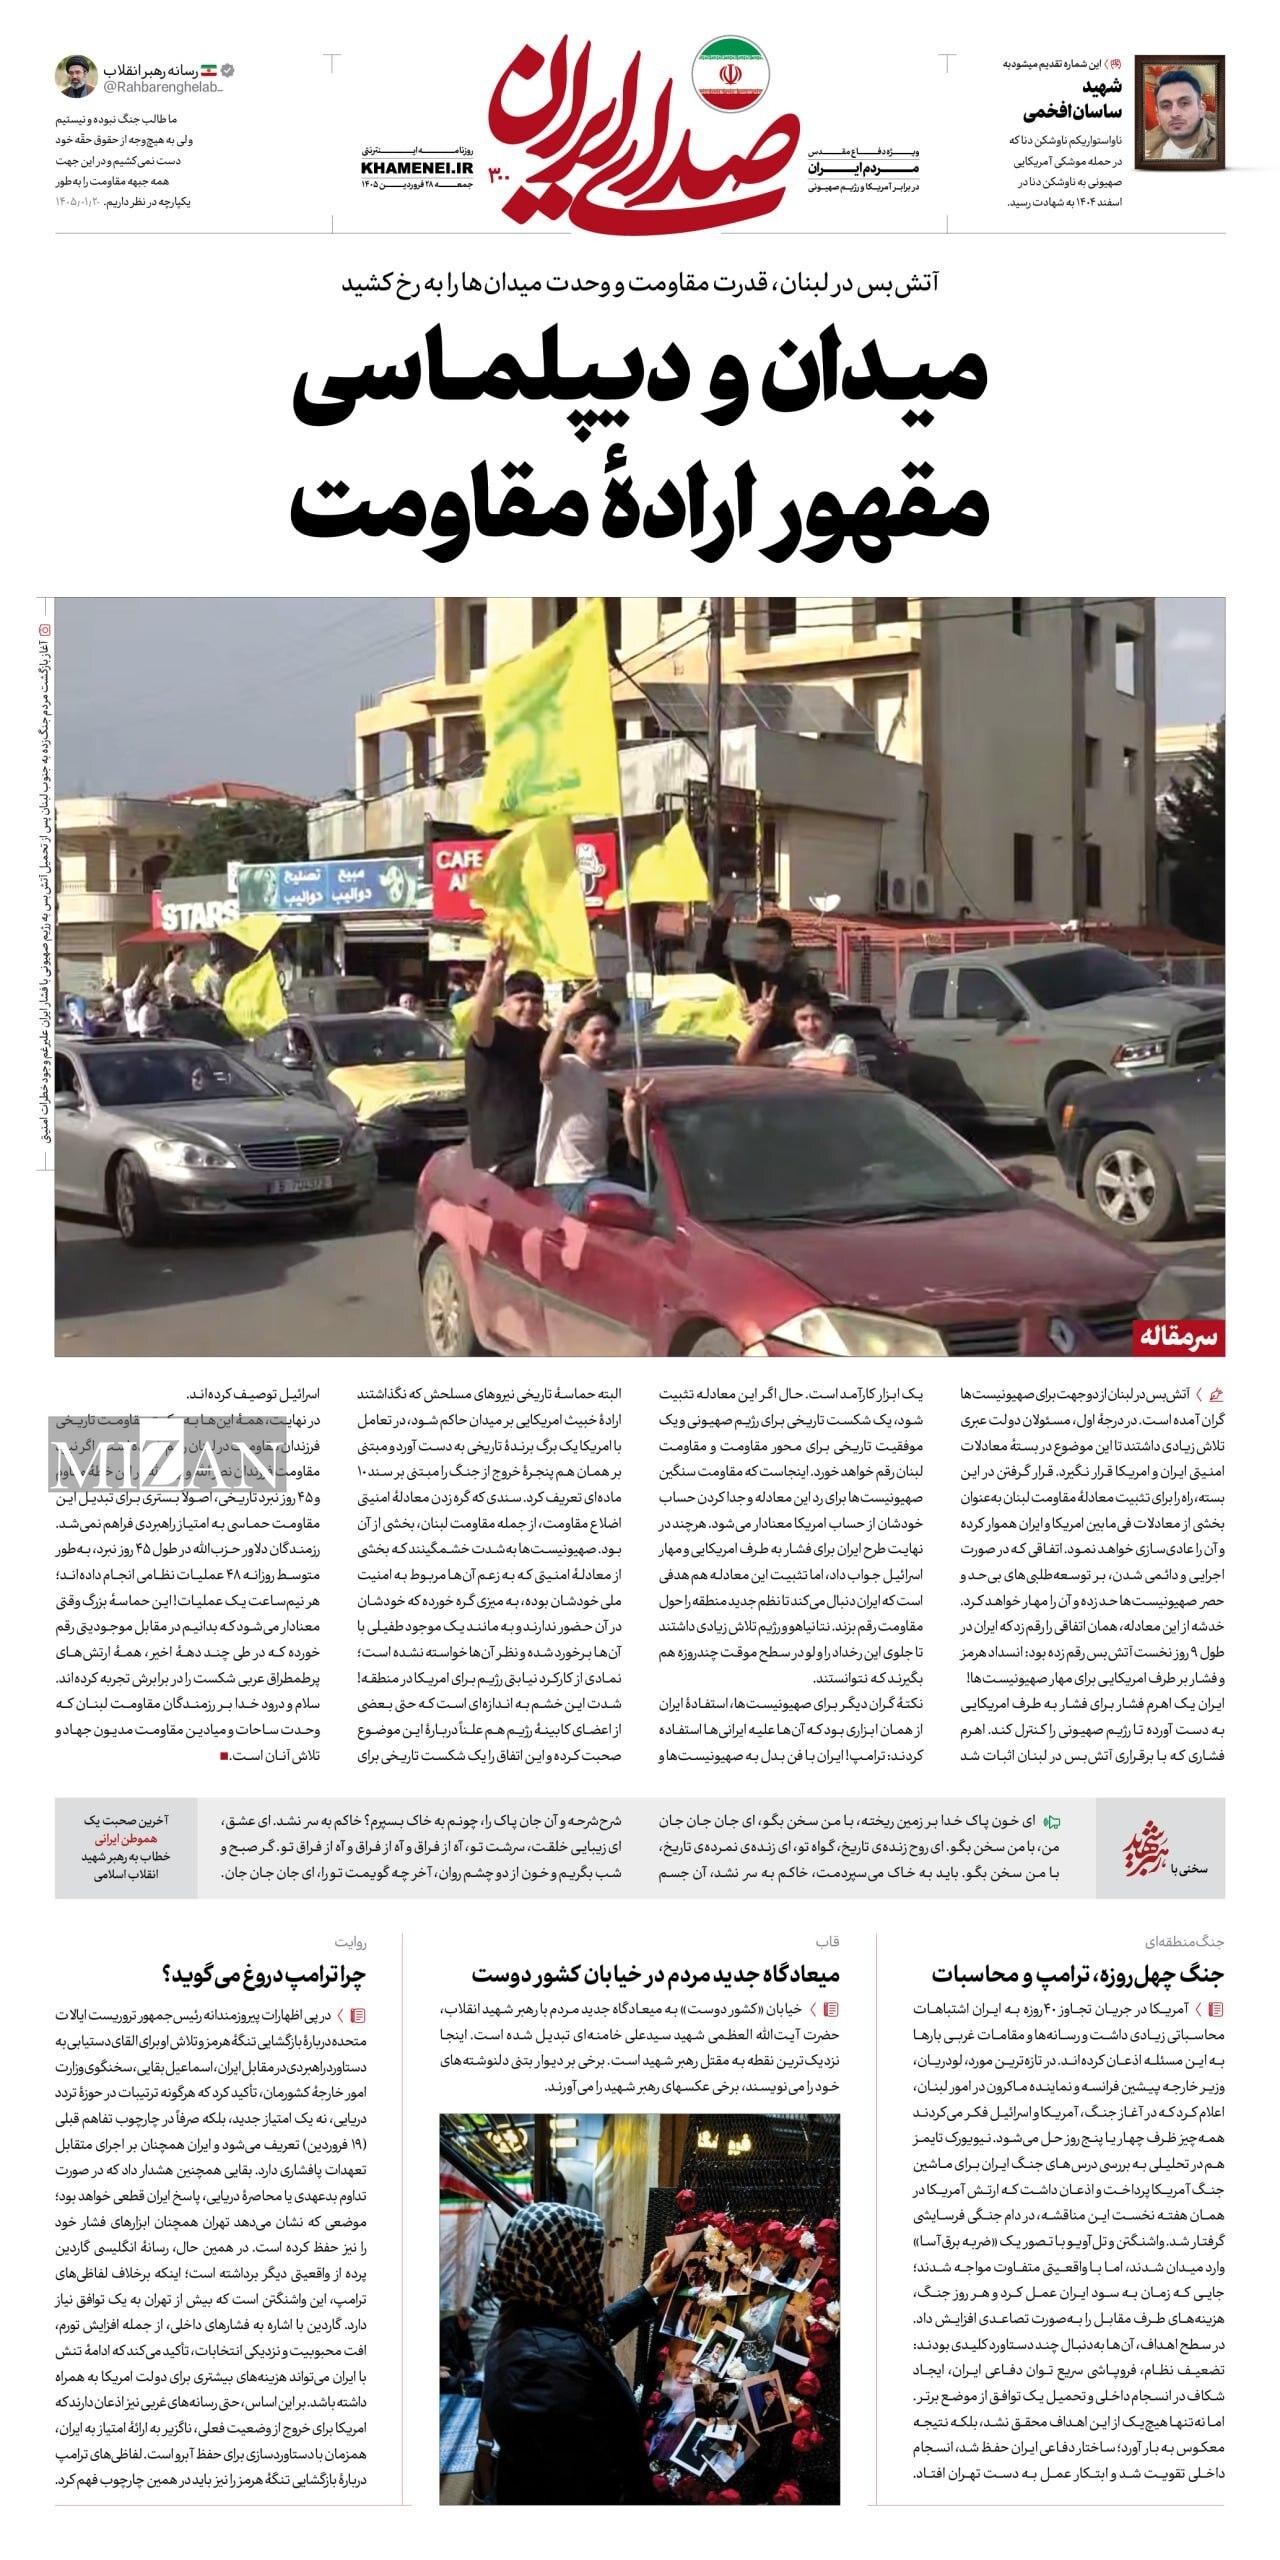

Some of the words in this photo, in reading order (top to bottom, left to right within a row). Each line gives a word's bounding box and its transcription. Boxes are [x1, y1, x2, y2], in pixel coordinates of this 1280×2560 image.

[103, 63, 141, 76] انقلاب
[140, 67, 167, 80] رهبر
[167, 63, 199, 80] رسانه
[1082, 77, 1123, 99] شهید
[117, 112, 141, 124] جنگ
[141, 113, 167, 124] طالب
[168, 113, 178, 124] ما
[1022, 100, 1073, 124] افخمی
[1072, 102, 1123, 121] ساسان
[55, 118, 86, 128] نیستیم
[86, 118, 93, 127] و
[93, 116, 117, 127] نبوده
[361, 162, 474, 174] KHAMENEI.IR
[807, 161, 863, 177] ایران
[862, 164, 920, 178] مردم
[341, 271, 395, 298] کشید
[395, 272, 421, 301] رخ
[424, 276, 444, 298] به
[446, 271, 459, 298] را
[546, 276, 611, 298] وحدت
[611, 280, 625, 298] و
[628, 271, 710, 298] مقاومت
[713, 270, 768, 298] قدرت
[772, 271, 829, 298] لبنان،
[829, 277, 854, 298] در
[292, 322, 691, 444] دیپلماسی
[761, 322, 988, 429] میدان
[699, 353, 750, 427] و
[290, 459, 590, 564] مقاومت
[757, 460, 990, 564] مقهور
[436, 848, 483, 871] CAFE
[1140, 1324, 1218, 1353] سرمقاله
[233, 1389, 278, 1403] توصیف
[278, 1387, 320, 1404] اسرائیل
[960, 1464, 980, 1481] این
[980, 1468, 995, 1481] در
[996, 1463, 1032, 1481] گرفتن
[1031, 1464, 1054, 1481] قرار
[1055, 1463, 1090, 1481] نگیرد.
[1090, 1464, 1114, 1481] قرار
[1115, 1464, 1151, 1481] امریکا
[1150, 1470, 1159, 1481] و
[1160, 1464, 1187, 1481] ایران
[1189, 1464, 1225, 1481] امنیتی
[83, 1814, 101, 1828] یک
[102, 1817, 137, 1829] صحبت
[138, 1814, 170, 1829] آخرین
[94, 1832, 120, 1847] ایرانی
[121, 1833, 158, 1847] هموطن
[81, 1851, 107, 1864] شهید
[106, 1853, 128, 1865] رهبر
[128, 1853, 139, 1865] به
[139, 1850, 171, 1865] خطاب
[93, 1868, 127, 1883] اسلامی
[127, 1868, 159, 1880] انقلاب
[1170, 1863, 1178, 1877] با
[1178, 1863, 1209, 1878] سخنی
[334, 1935, 368, 1952] روایت
[815, 1935, 840, 1951] قاب
[242, 1962, 284, 1992] دروغ
[284, 1963, 339, 1992] ترامپ
[339, 1964, 367, 1992] چرا
[471, 1968, 532, 1989] دوست
[531, 1963, 582, 1989] کشور
[583, 1963, 642, 1989] خیابان
[642, 1968, 665, 1989] در
[667, 1968, 711, 1992] مردم
[713, 1968, 761, 1989] جدید
[762, 1961, 841, 1989] میعادگاه
[931, 1963, 1019, 1989] محاسبات
[1020, 1971, 1033, 1989] و
[1035, 1963, 1090, 1992] ترامپ
[1179, 1961, 1225, 1989] جنگ
[439, 2028, 468, 2044] اینجا
[470, 2028, 504, 2041] است.
[506, 2030, 533, 2041] شده
[535, 2028, 571, 2045] تبدیل
[673, 2029, 705, 2044] شهید
[707, 2028, 753, 2045] العظمی
[803, 2031, 840, 2044] حضرت
